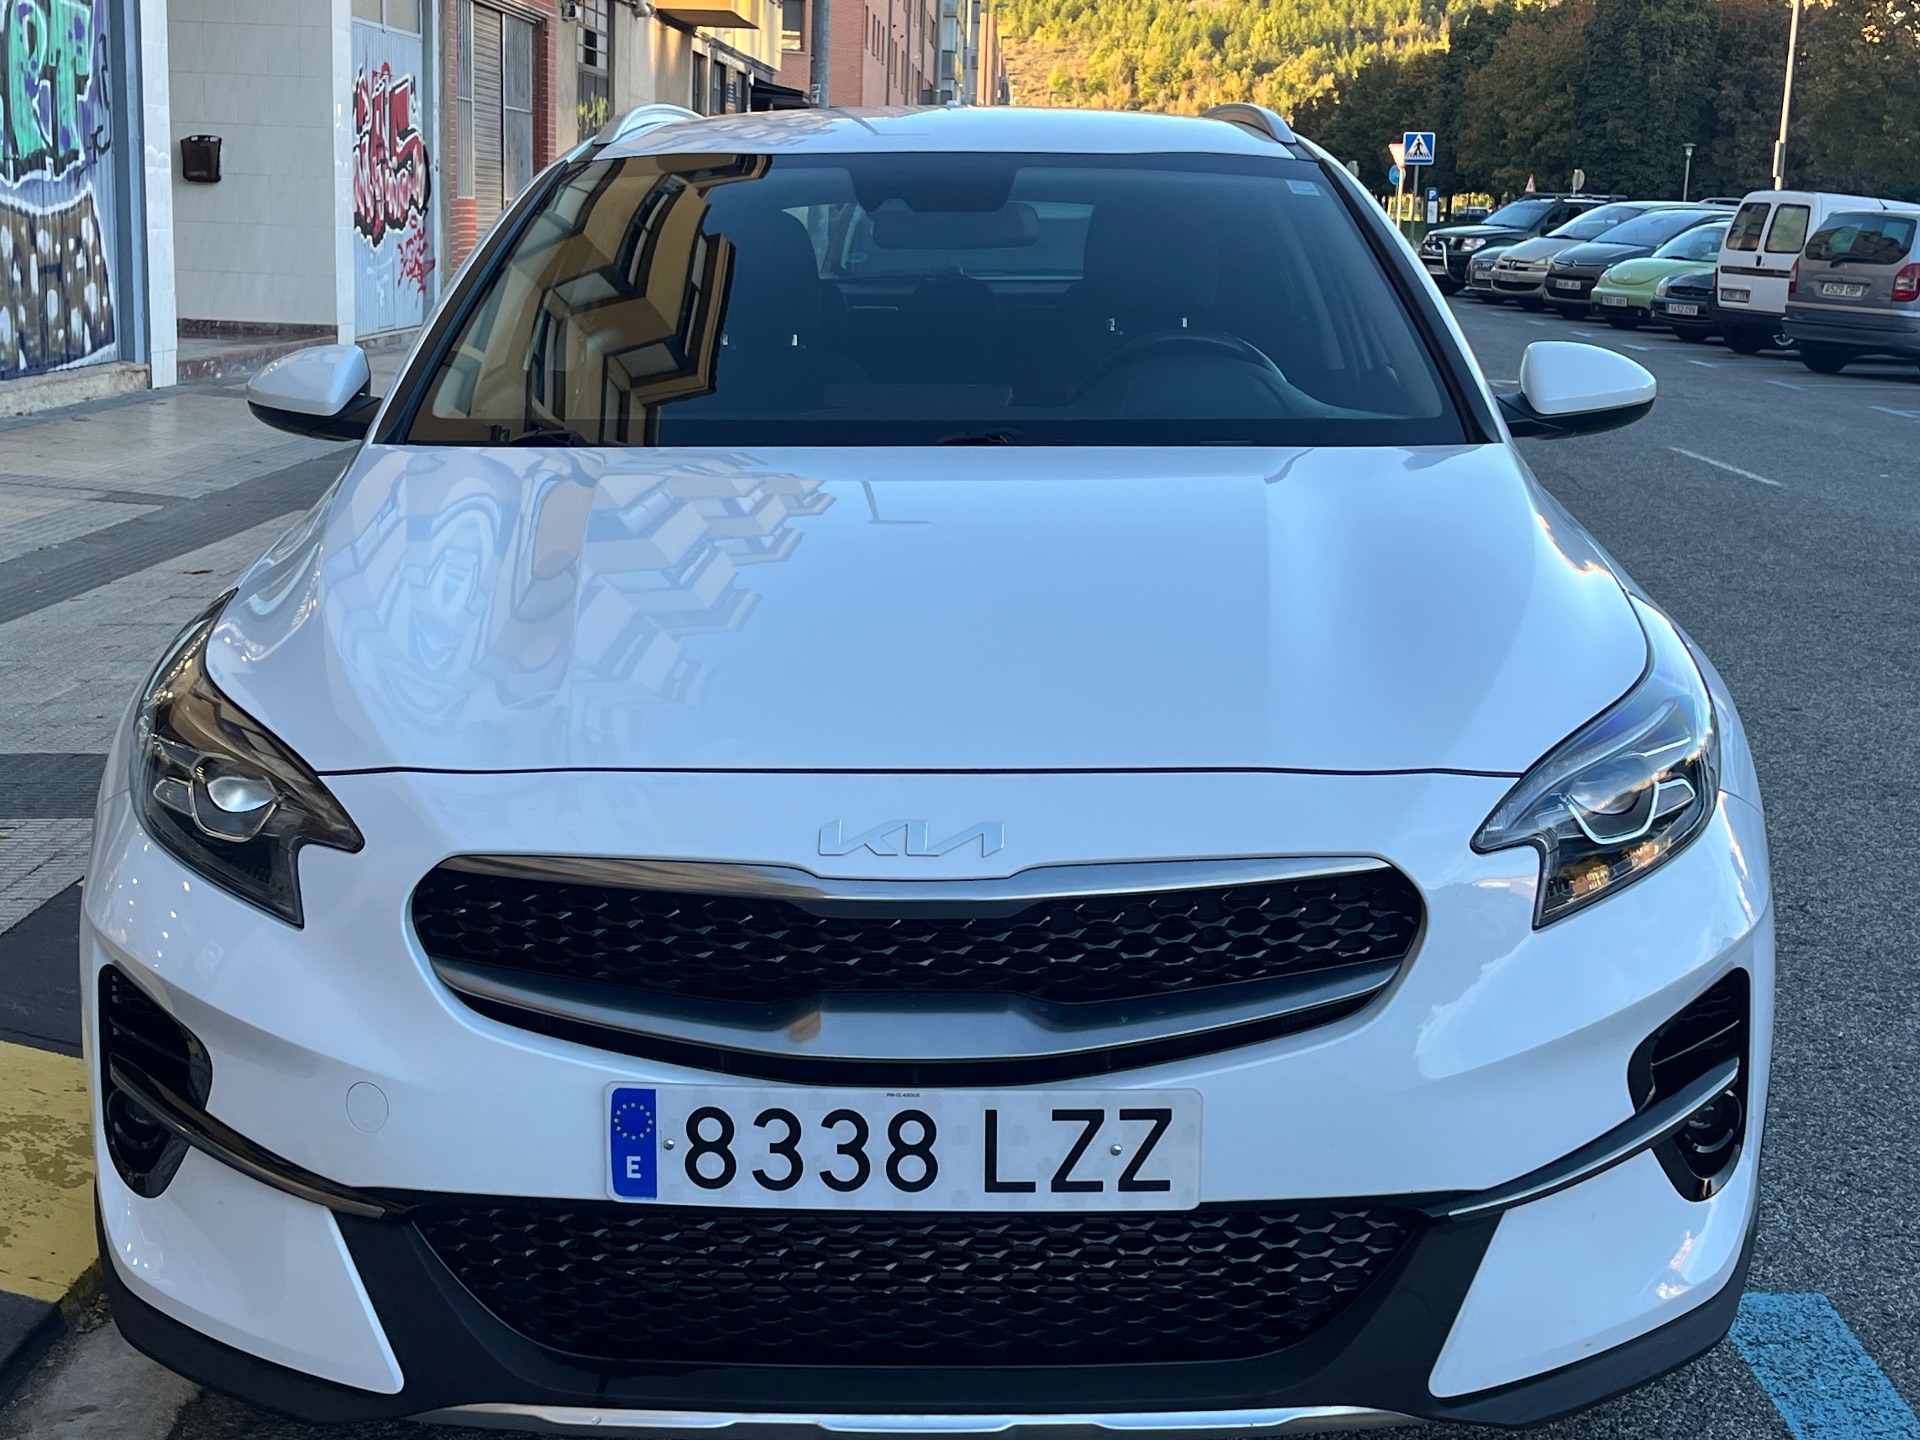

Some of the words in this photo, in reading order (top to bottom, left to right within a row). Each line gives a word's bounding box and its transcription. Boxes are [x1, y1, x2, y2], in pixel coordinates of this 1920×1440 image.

[1428, 189, 1437, 200] P
[817, 818, 1006, 858] KIA
[684, 1106, 939, 1192] 8338
[984, 1109, 1173, 1193] LZZ
[626, 1157, 641, 1179] E
